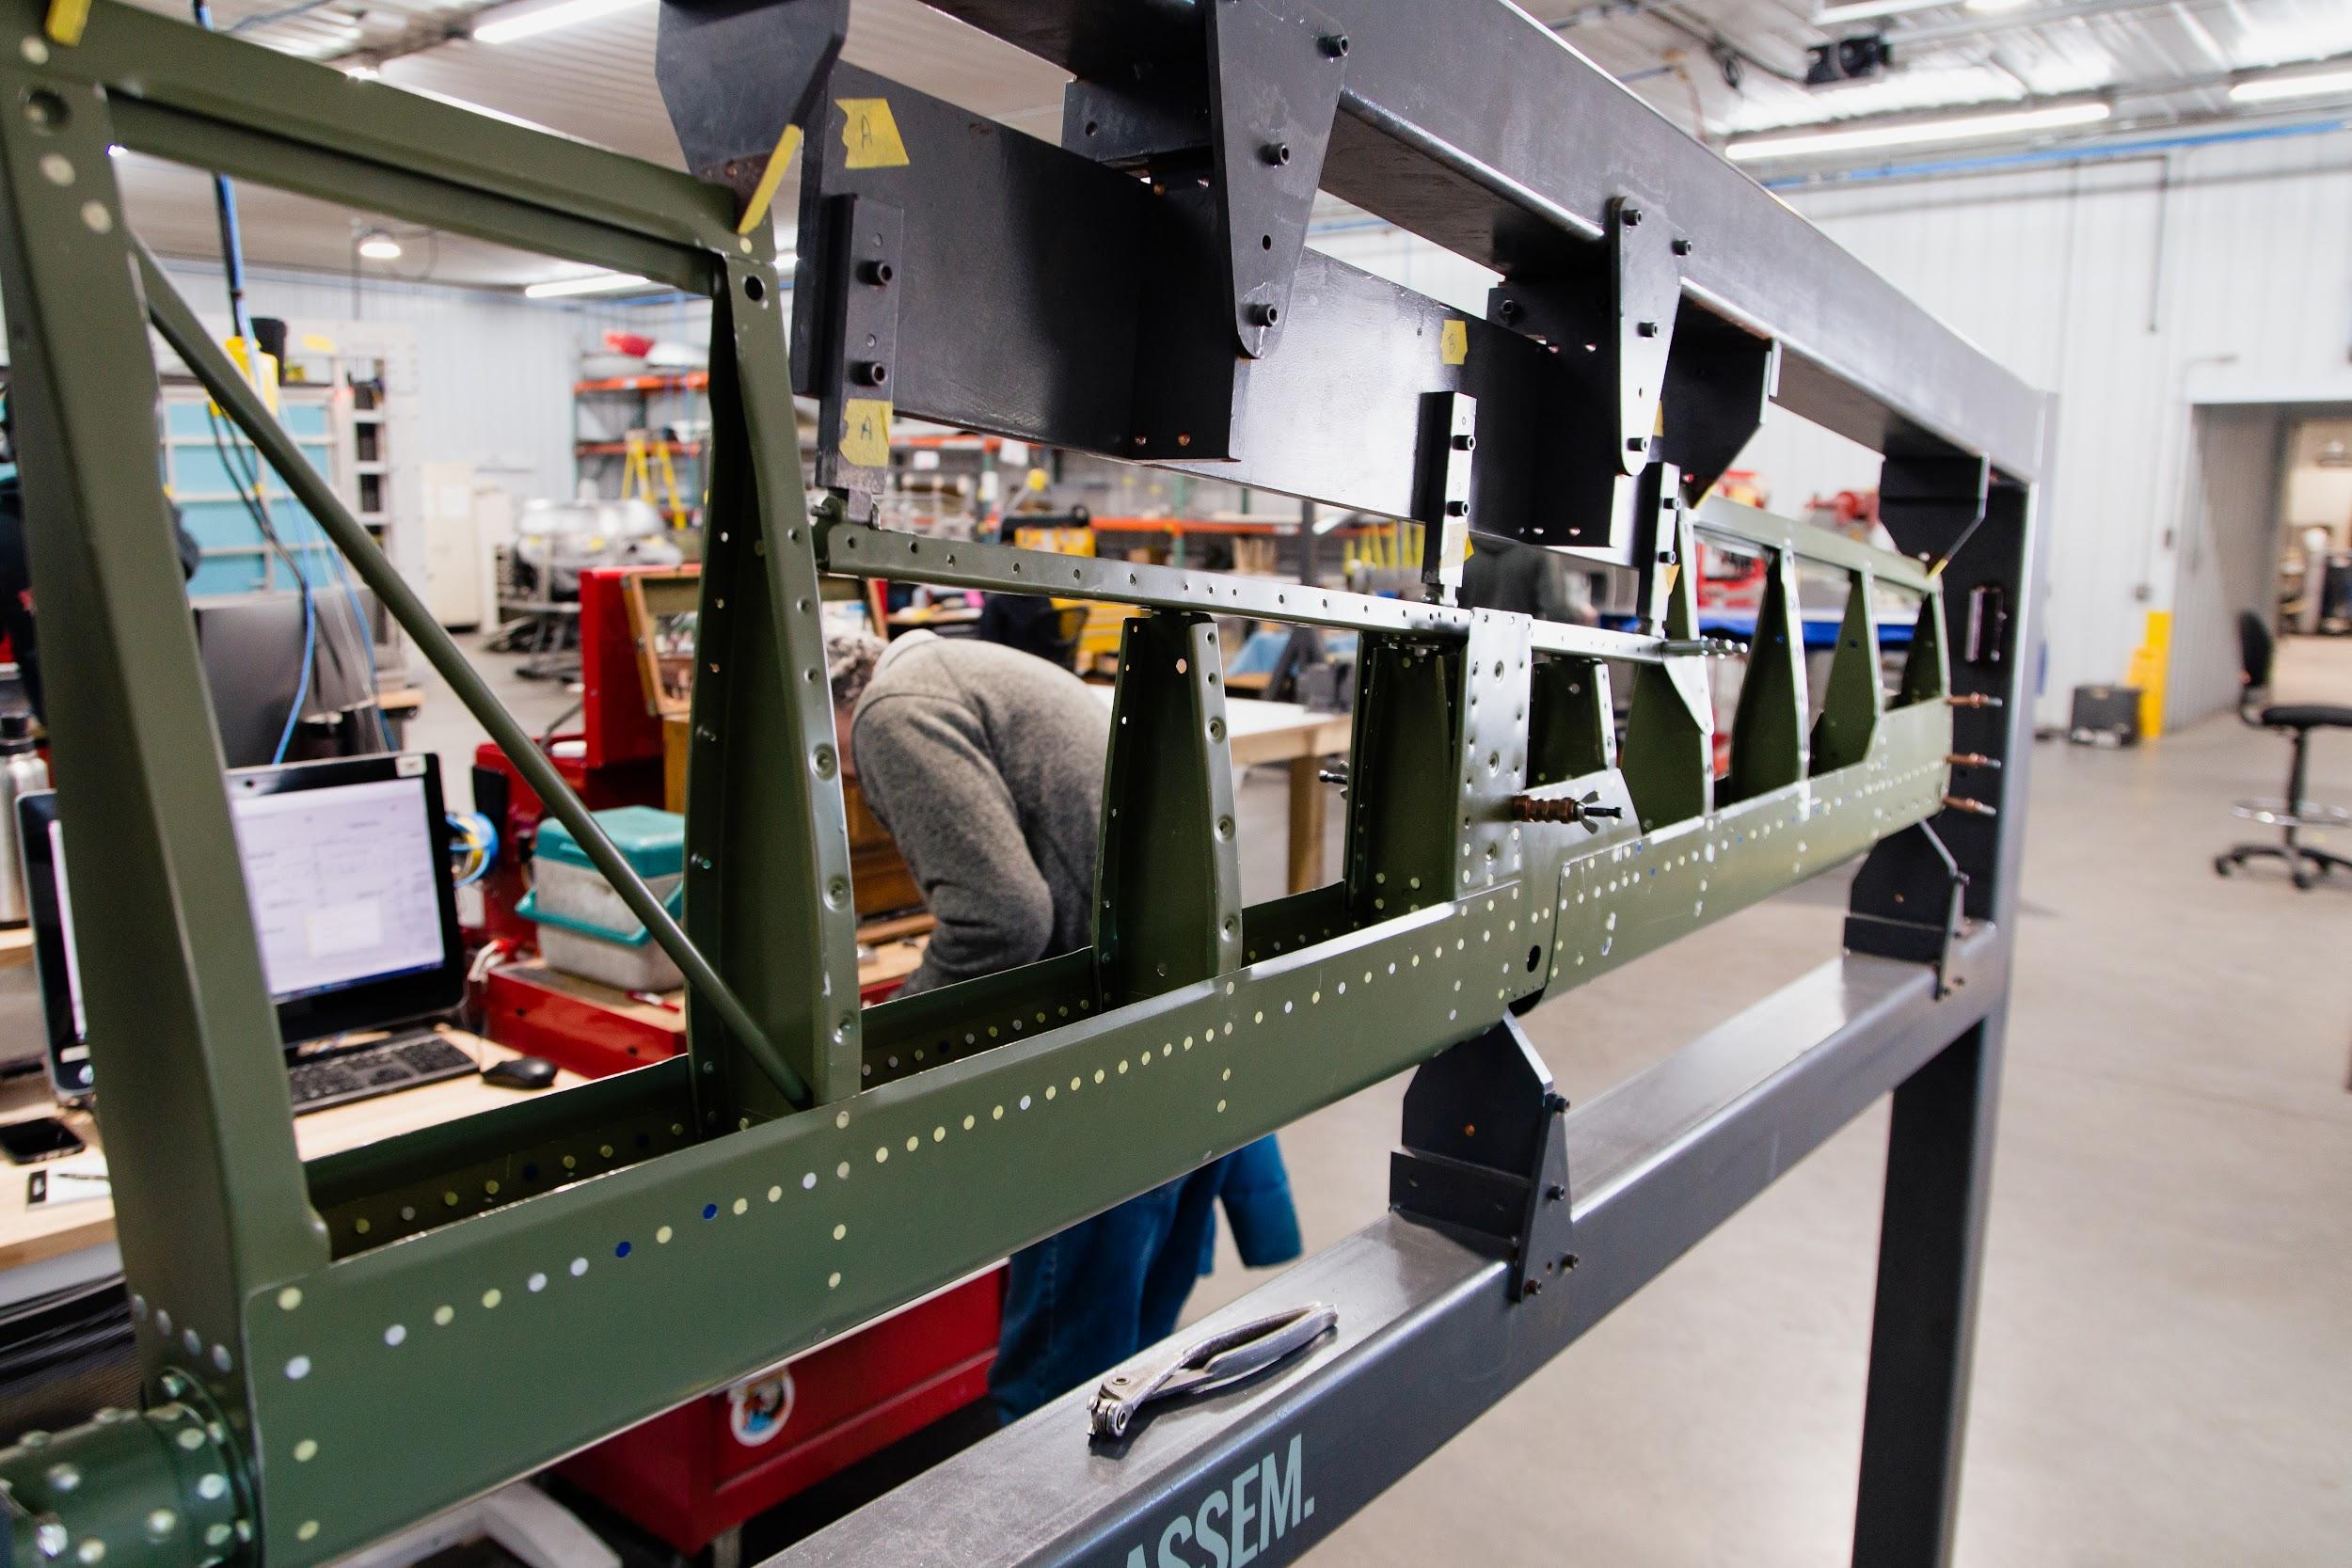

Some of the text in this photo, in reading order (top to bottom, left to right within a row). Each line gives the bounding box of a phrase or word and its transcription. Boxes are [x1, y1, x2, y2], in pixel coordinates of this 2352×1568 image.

[861, 114, 873, 150] A
[860, 415, 873, 441] A
[1126, 1433, 1315, 1568] SSEM.
